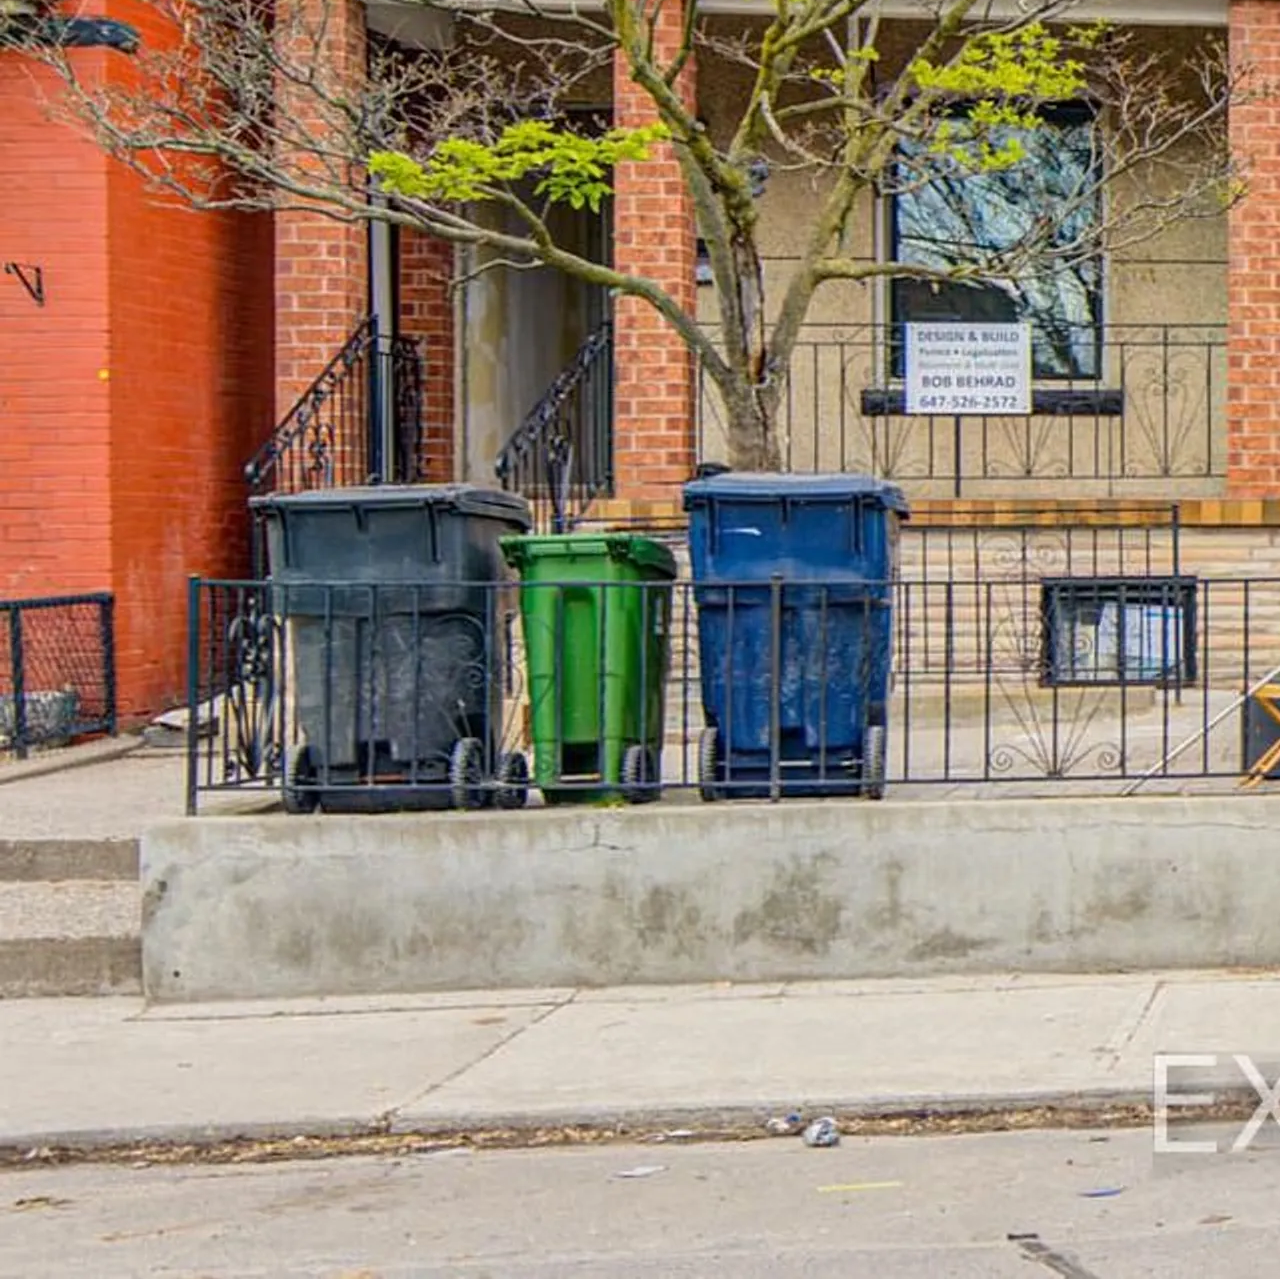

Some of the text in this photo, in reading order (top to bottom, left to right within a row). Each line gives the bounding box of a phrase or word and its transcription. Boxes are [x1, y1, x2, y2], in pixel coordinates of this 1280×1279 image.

[917, 331, 1020, 342] DESIGN & BUILD
[921, 375, 1016, 388] BOB BEHRAD
